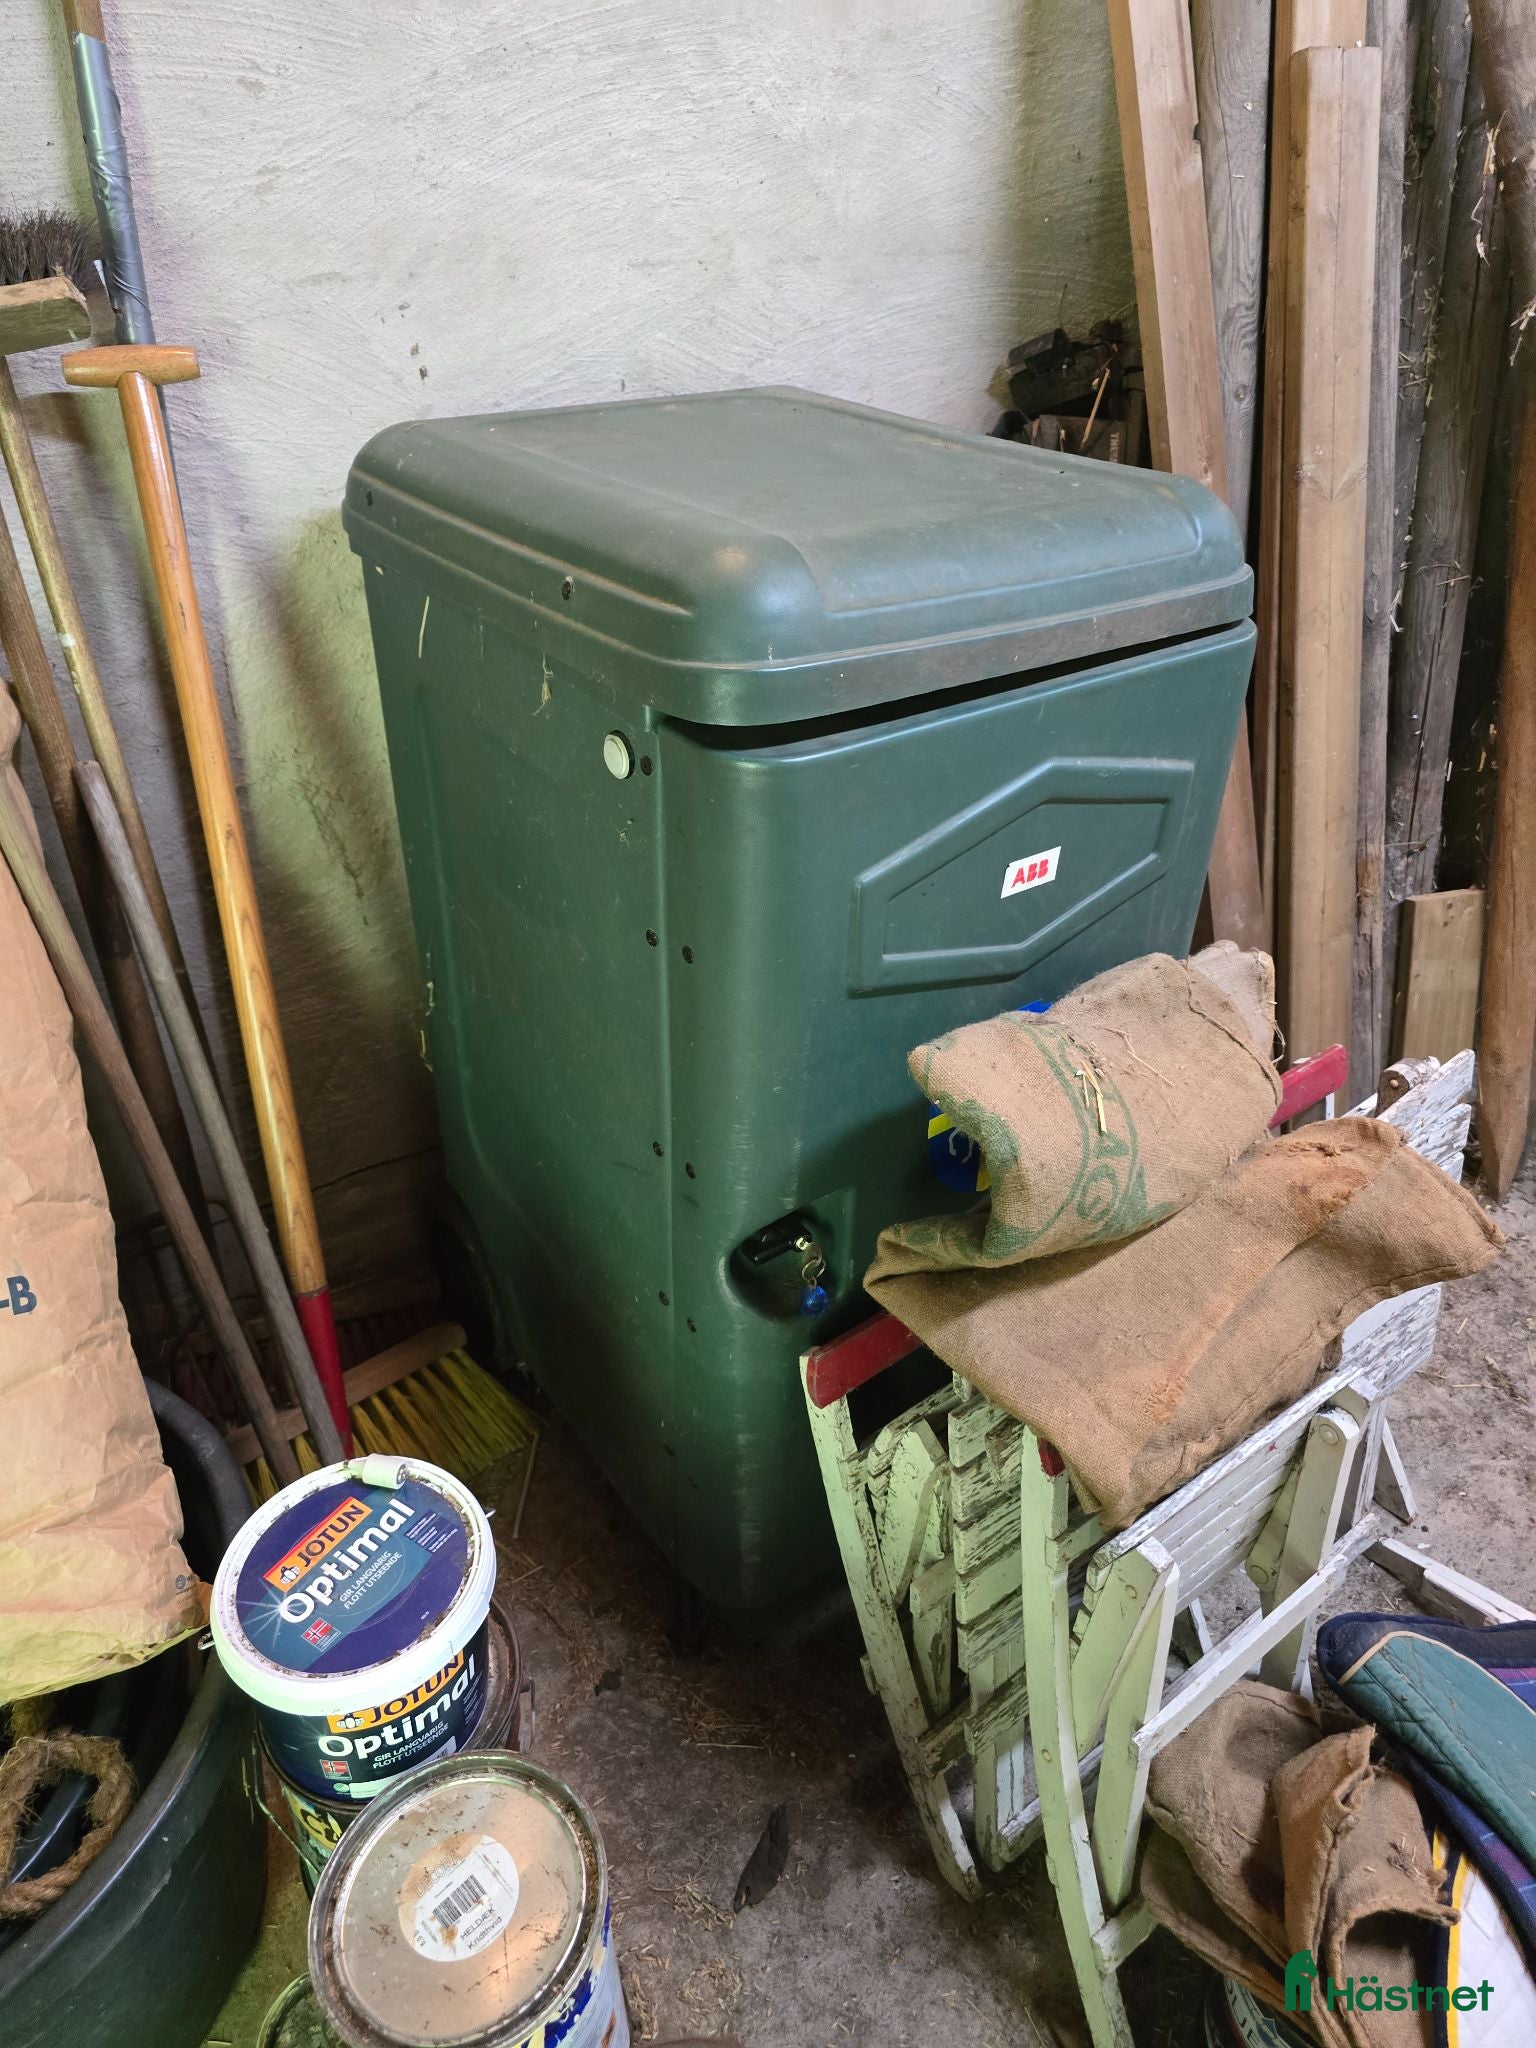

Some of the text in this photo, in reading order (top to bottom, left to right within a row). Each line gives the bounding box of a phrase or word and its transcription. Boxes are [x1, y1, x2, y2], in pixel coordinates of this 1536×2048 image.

[1010, 858, 1049, 888] ABB
[279, 1498, 416, 1624] Optimal
[297, 1504, 365, 1567] JOTUN
[340, 1550, 392, 1602] GIR LANGVARIG
[344, 1551, 403, 1610] FLOTT UTSEENDE
[318, 1653, 476, 1760] Optimal
[370, 1655, 459, 1724] JOTUN
[372, 1753, 404, 1770] FLOTT
[404, 1722, 450, 1762] UTSEENDE
[375, 1751, 392, 1763] GIR
[393, 1720, 445, 1757] LANGVARIG
